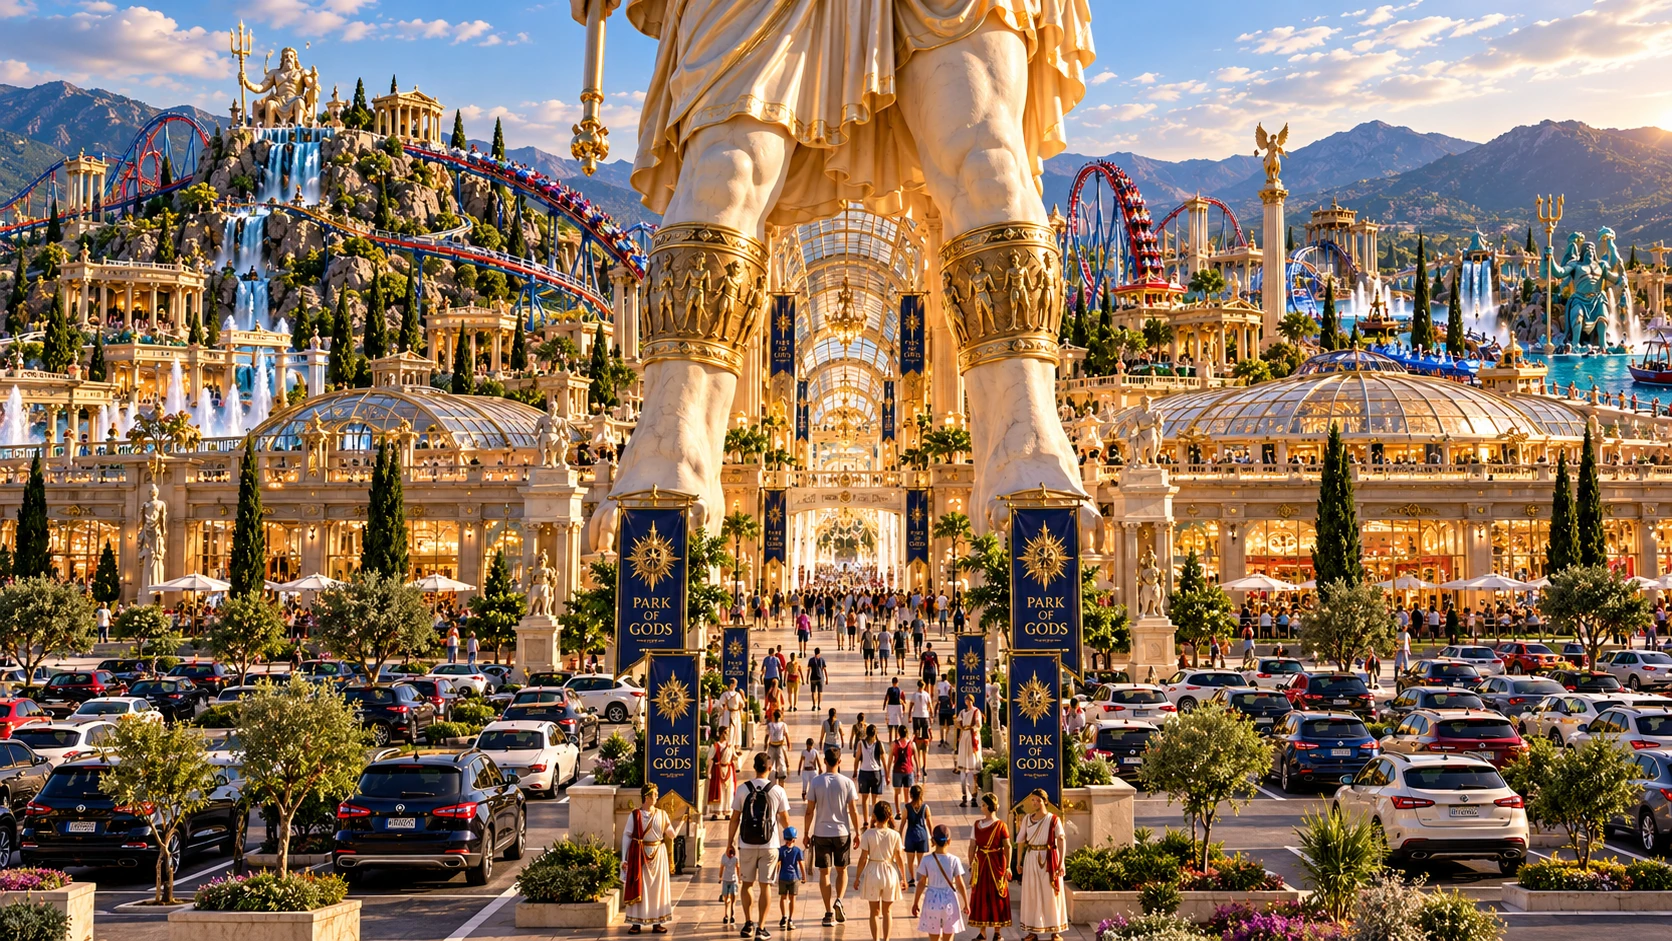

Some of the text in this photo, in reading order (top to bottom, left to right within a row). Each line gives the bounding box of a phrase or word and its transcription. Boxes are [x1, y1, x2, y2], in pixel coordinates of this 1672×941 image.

[633, 596, 671, 609] PARK
[1027, 596, 1065, 609] PARK
[643, 610, 660, 621] OF
[1037, 610, 1054, 621] OF
[629, 622, 673, 636] GODS
[1024, 621, 1069, 636] GODS
[656, 734, 690, 746] PARK
[1018, 734, 1052, 746] PARK
[665, 746, 680, 756] OF
[1028, 746, 1042, 757] OF
[652, 757, 692, 770] GODS
[1016, 757, 1055, 770] GODS
